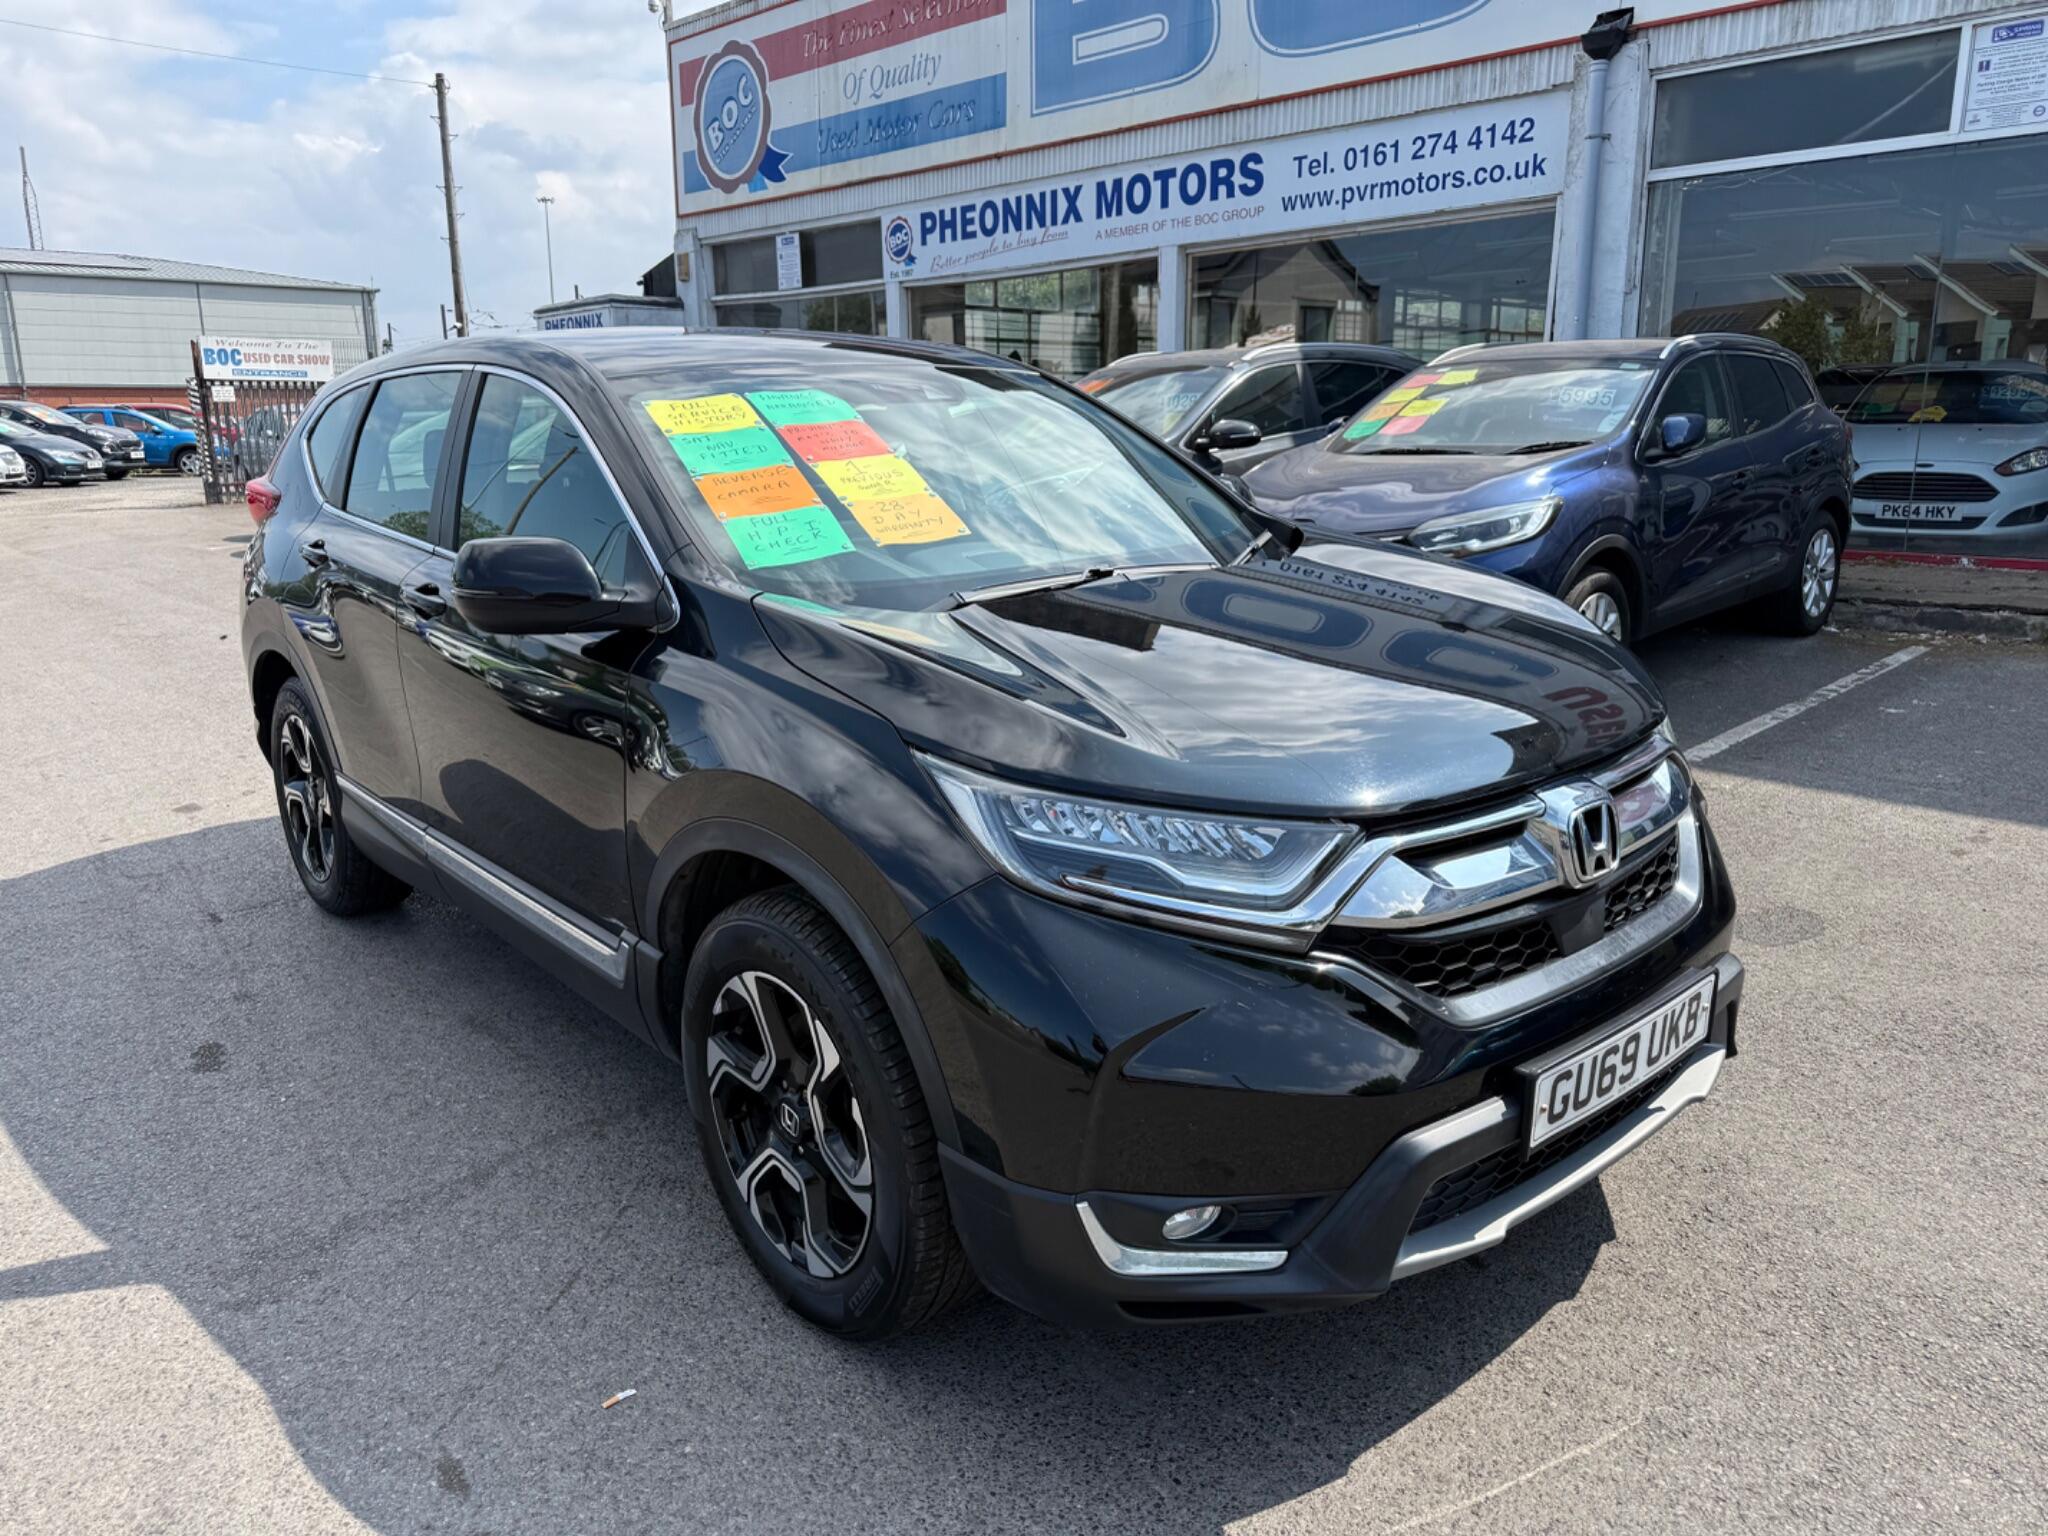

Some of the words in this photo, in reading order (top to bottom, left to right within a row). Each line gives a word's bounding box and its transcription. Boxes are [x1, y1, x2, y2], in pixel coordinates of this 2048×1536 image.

[803, 31, 833, 57] The
[839, 9, 894, 46] Finest
[843, 69, 867, 105] Of
[870, 52, 942, 99] Quality
[707, 73, 753, 153] BOC
[818, 122, 859, 154] Used
[863, 110, 923, 146] Motor
[926, 98, 976, 130] Cars
[1292, 152, 1335, 178] Tel.
[1343, 139, 1400, 171] 0161
[1411, 130, 1459, 161] 274
[1467, 117, 1536, 151] 4142
[920, 184, 1083, 247] PHEONNIX
[1095, 151, 1265, 219] MOTORS
[1282, 153, 1548, 212] www.pvrmotors.co.uk
[889, 228, 909, 247] BOC
[1095, 230, 1104, 240] A
[1105, 224, 1149, 239] MEMBER
[1152, 219, 1167, 232] OF
[1170, 215, 1192, 230] THE
[1194, 212, 1219, 226] BOC
[1221, 205, 1265, 222] GROUP
[930, 255, 962, 272] Better
[965, 238, 999, 262] people
[1002, 240, 1013, 251] to
[1016, 231, 1037, 247] buy
[1040, 226, 1069, 245] from
[203, 348, 242, 366] BOC
[243, 352, 273, 364] USED
[273, 353, 295, 365] CAR
[297, 354, 330, 366] SHOW
[215, 339, 272, 348] Welcome
[276, 341, 292, 349] To
[297, 341, 319, 350] The
[750, 514, 797, 528] FULL
[1925, 505, 1957, 519] HKY
[754, 530, 828, 552] CHECK
[1547, 1032, 1641, 1125] GU69
[1646, 991, 1702, 1068] UKB
